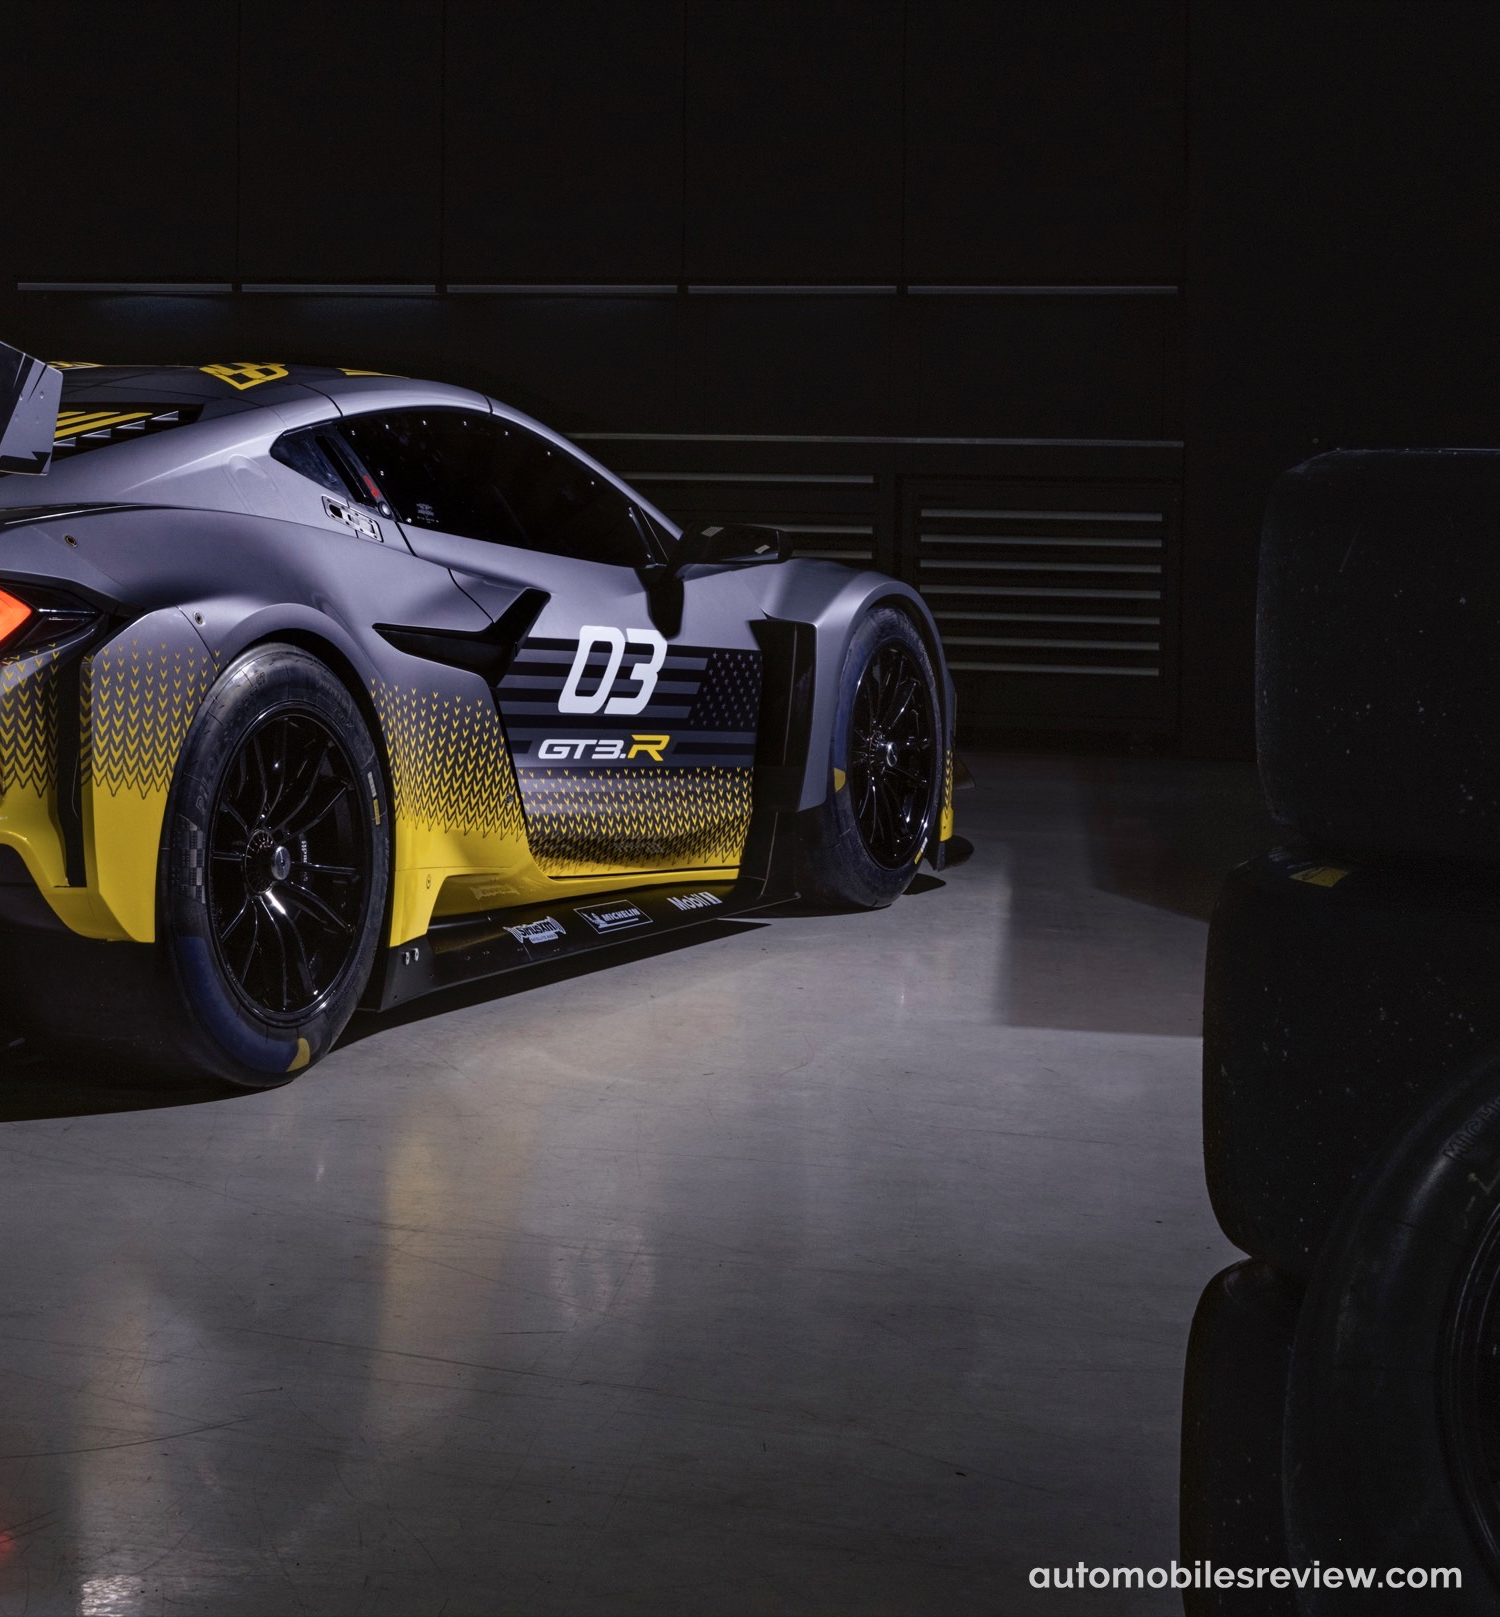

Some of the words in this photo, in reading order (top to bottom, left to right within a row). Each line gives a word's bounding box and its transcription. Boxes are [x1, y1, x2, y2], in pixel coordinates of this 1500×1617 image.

[557, 625, 668, 716] 03
[537, 734, 671, 762] GT3.R
[666, 893, 712, 911] Mobil
[602, 908, 641, 922] MICHELIN
